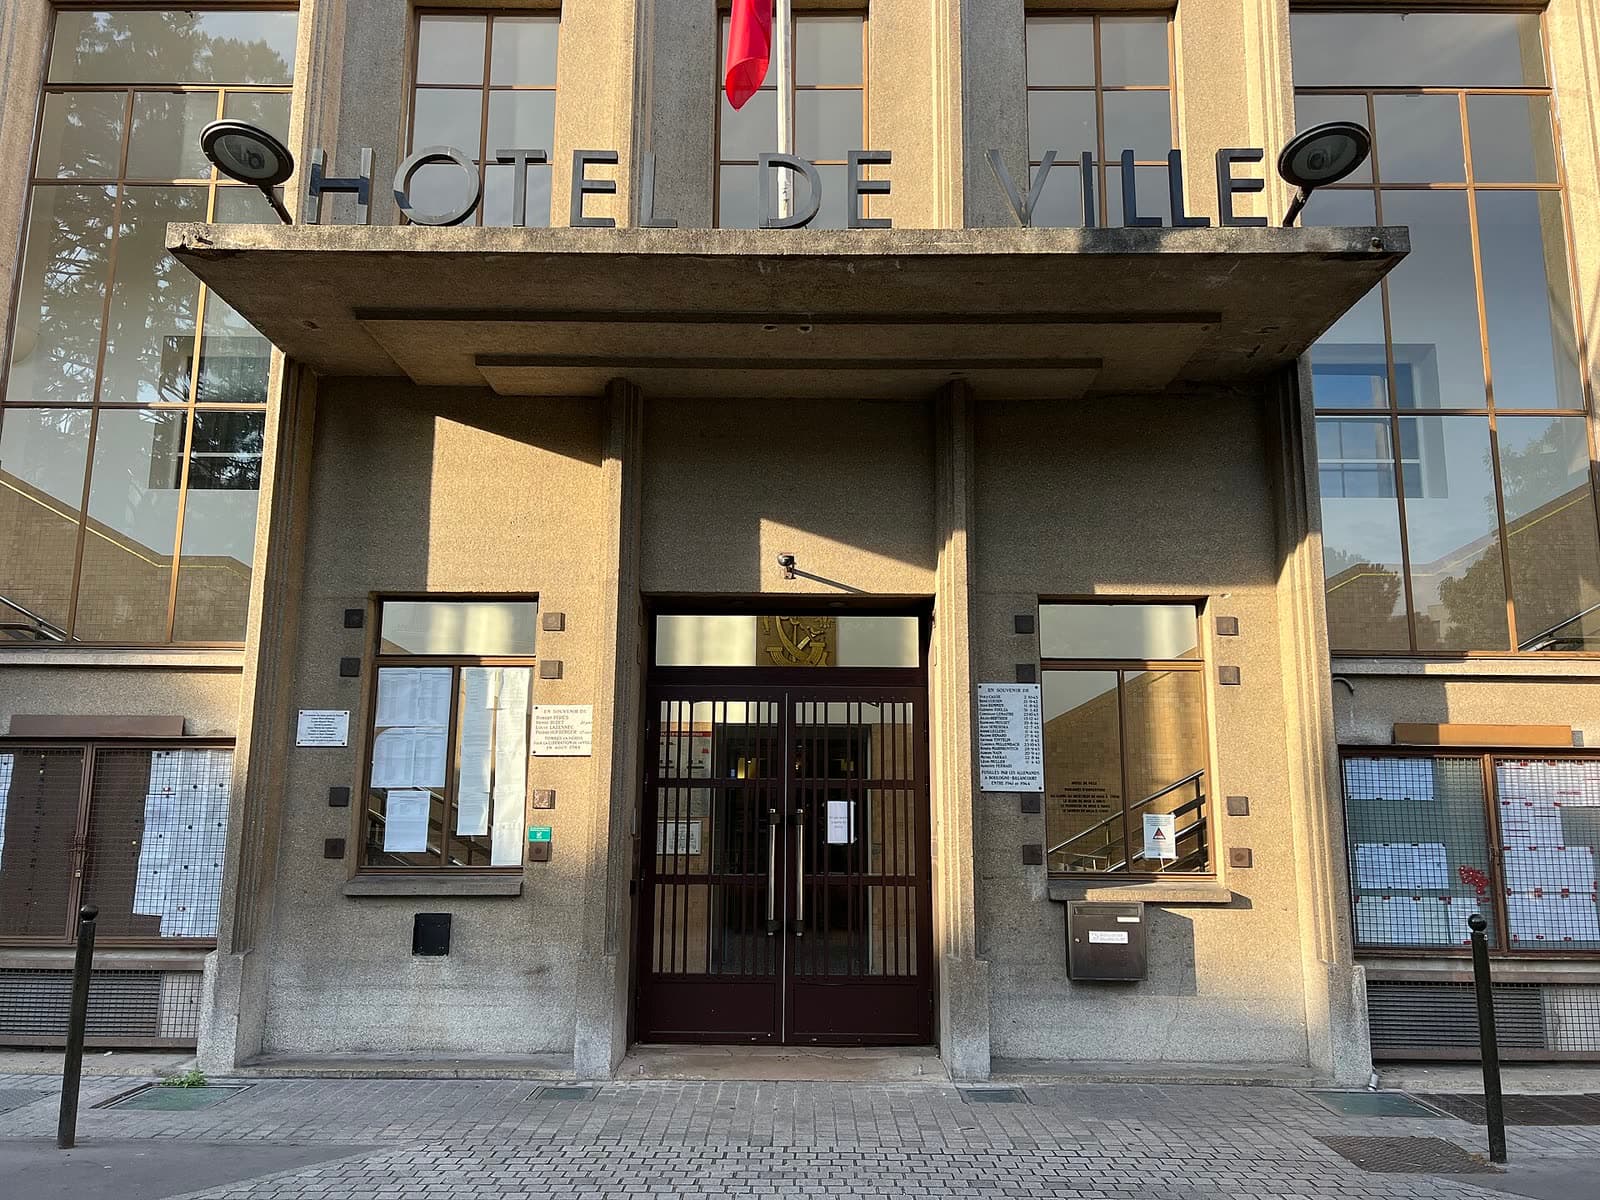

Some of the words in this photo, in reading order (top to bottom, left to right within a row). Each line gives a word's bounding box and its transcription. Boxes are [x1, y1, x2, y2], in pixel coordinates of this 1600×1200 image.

[305, 145, 677, 228] HOTEL
[758, 149, 893, 229] DE
[985, 148, 1268, 228] VILLE
